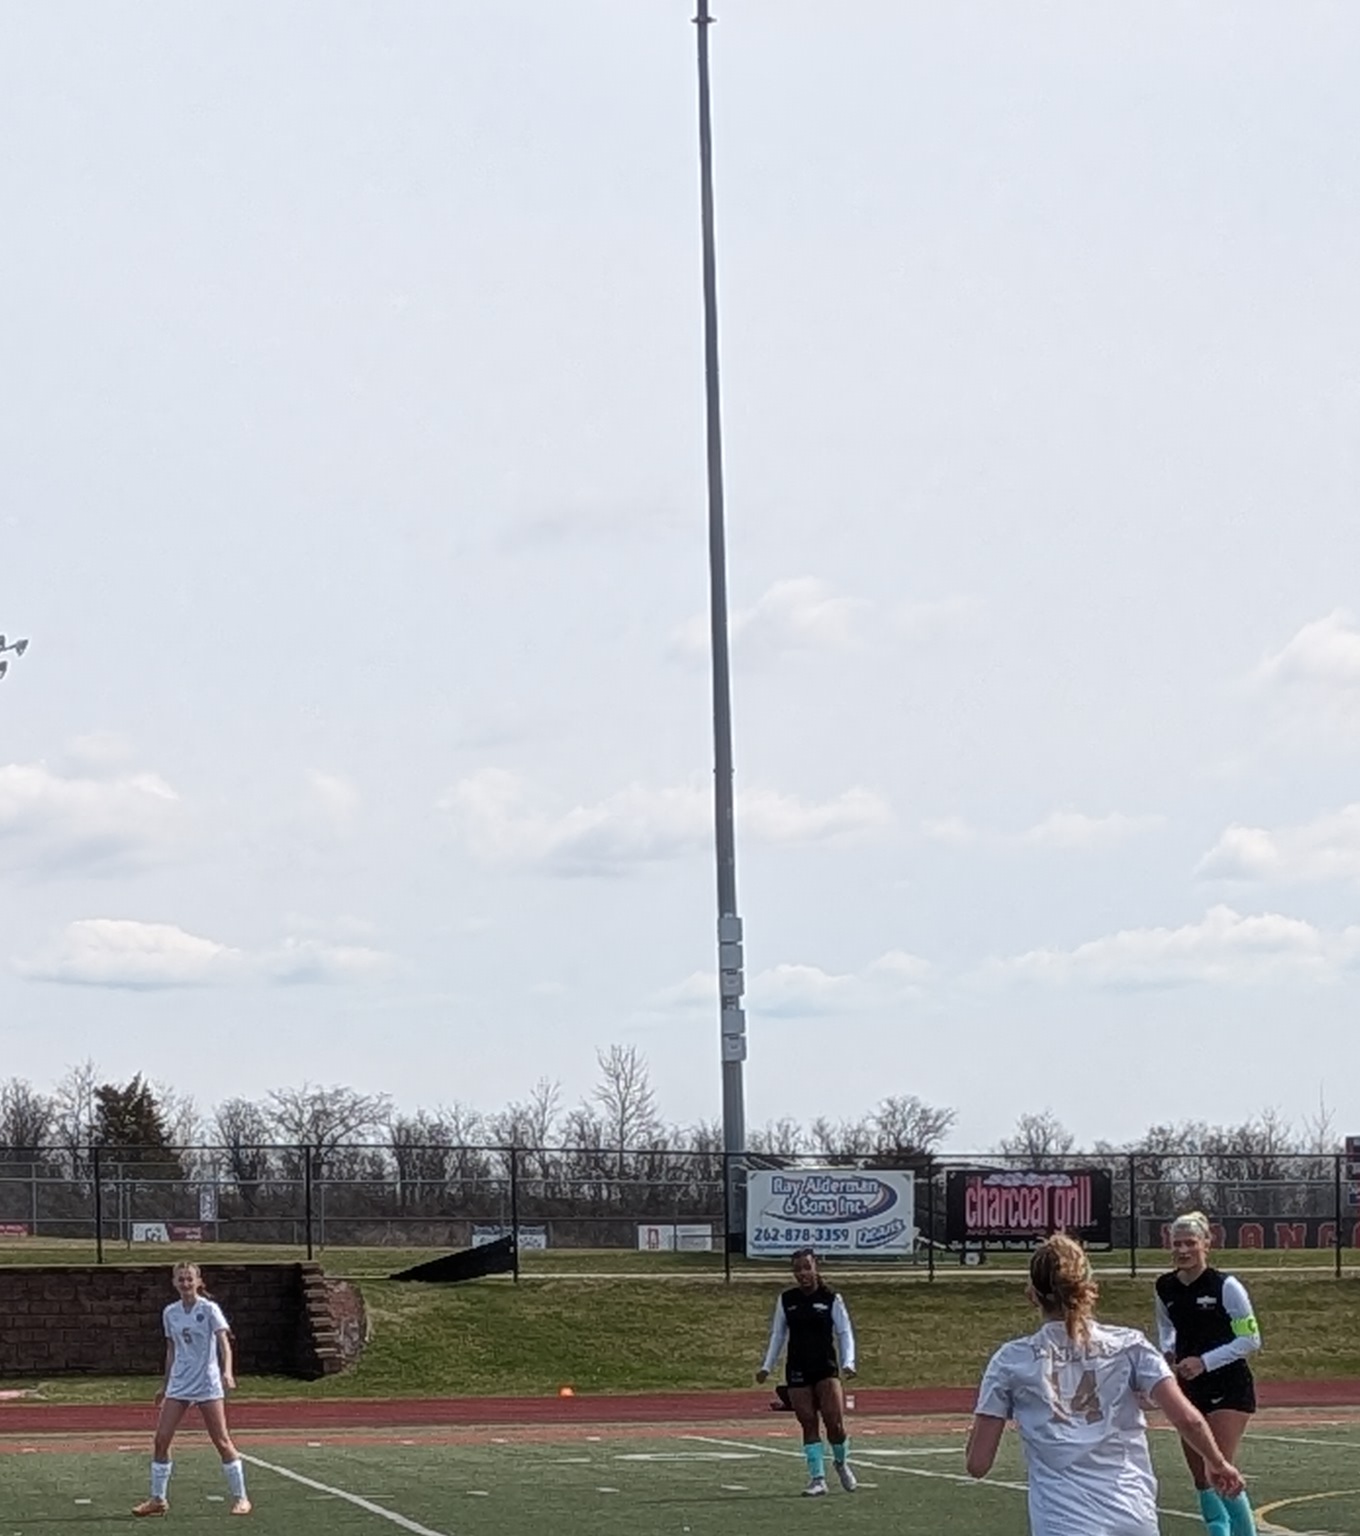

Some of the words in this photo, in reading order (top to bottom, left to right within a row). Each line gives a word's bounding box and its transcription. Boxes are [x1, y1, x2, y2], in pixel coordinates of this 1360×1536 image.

[772, 1176, 802, 1196] Ray
[803, 1175, 879, 1194] Alderman
[783, 1197, 796, 1214] &
[799, 1196, 837, 1215] Sons
[965, 1175, 1049, 1228] charcoal
[1054, 1175, 1092, 1235] grill
[754, 1228, 849, 1242] 262-878-3359
